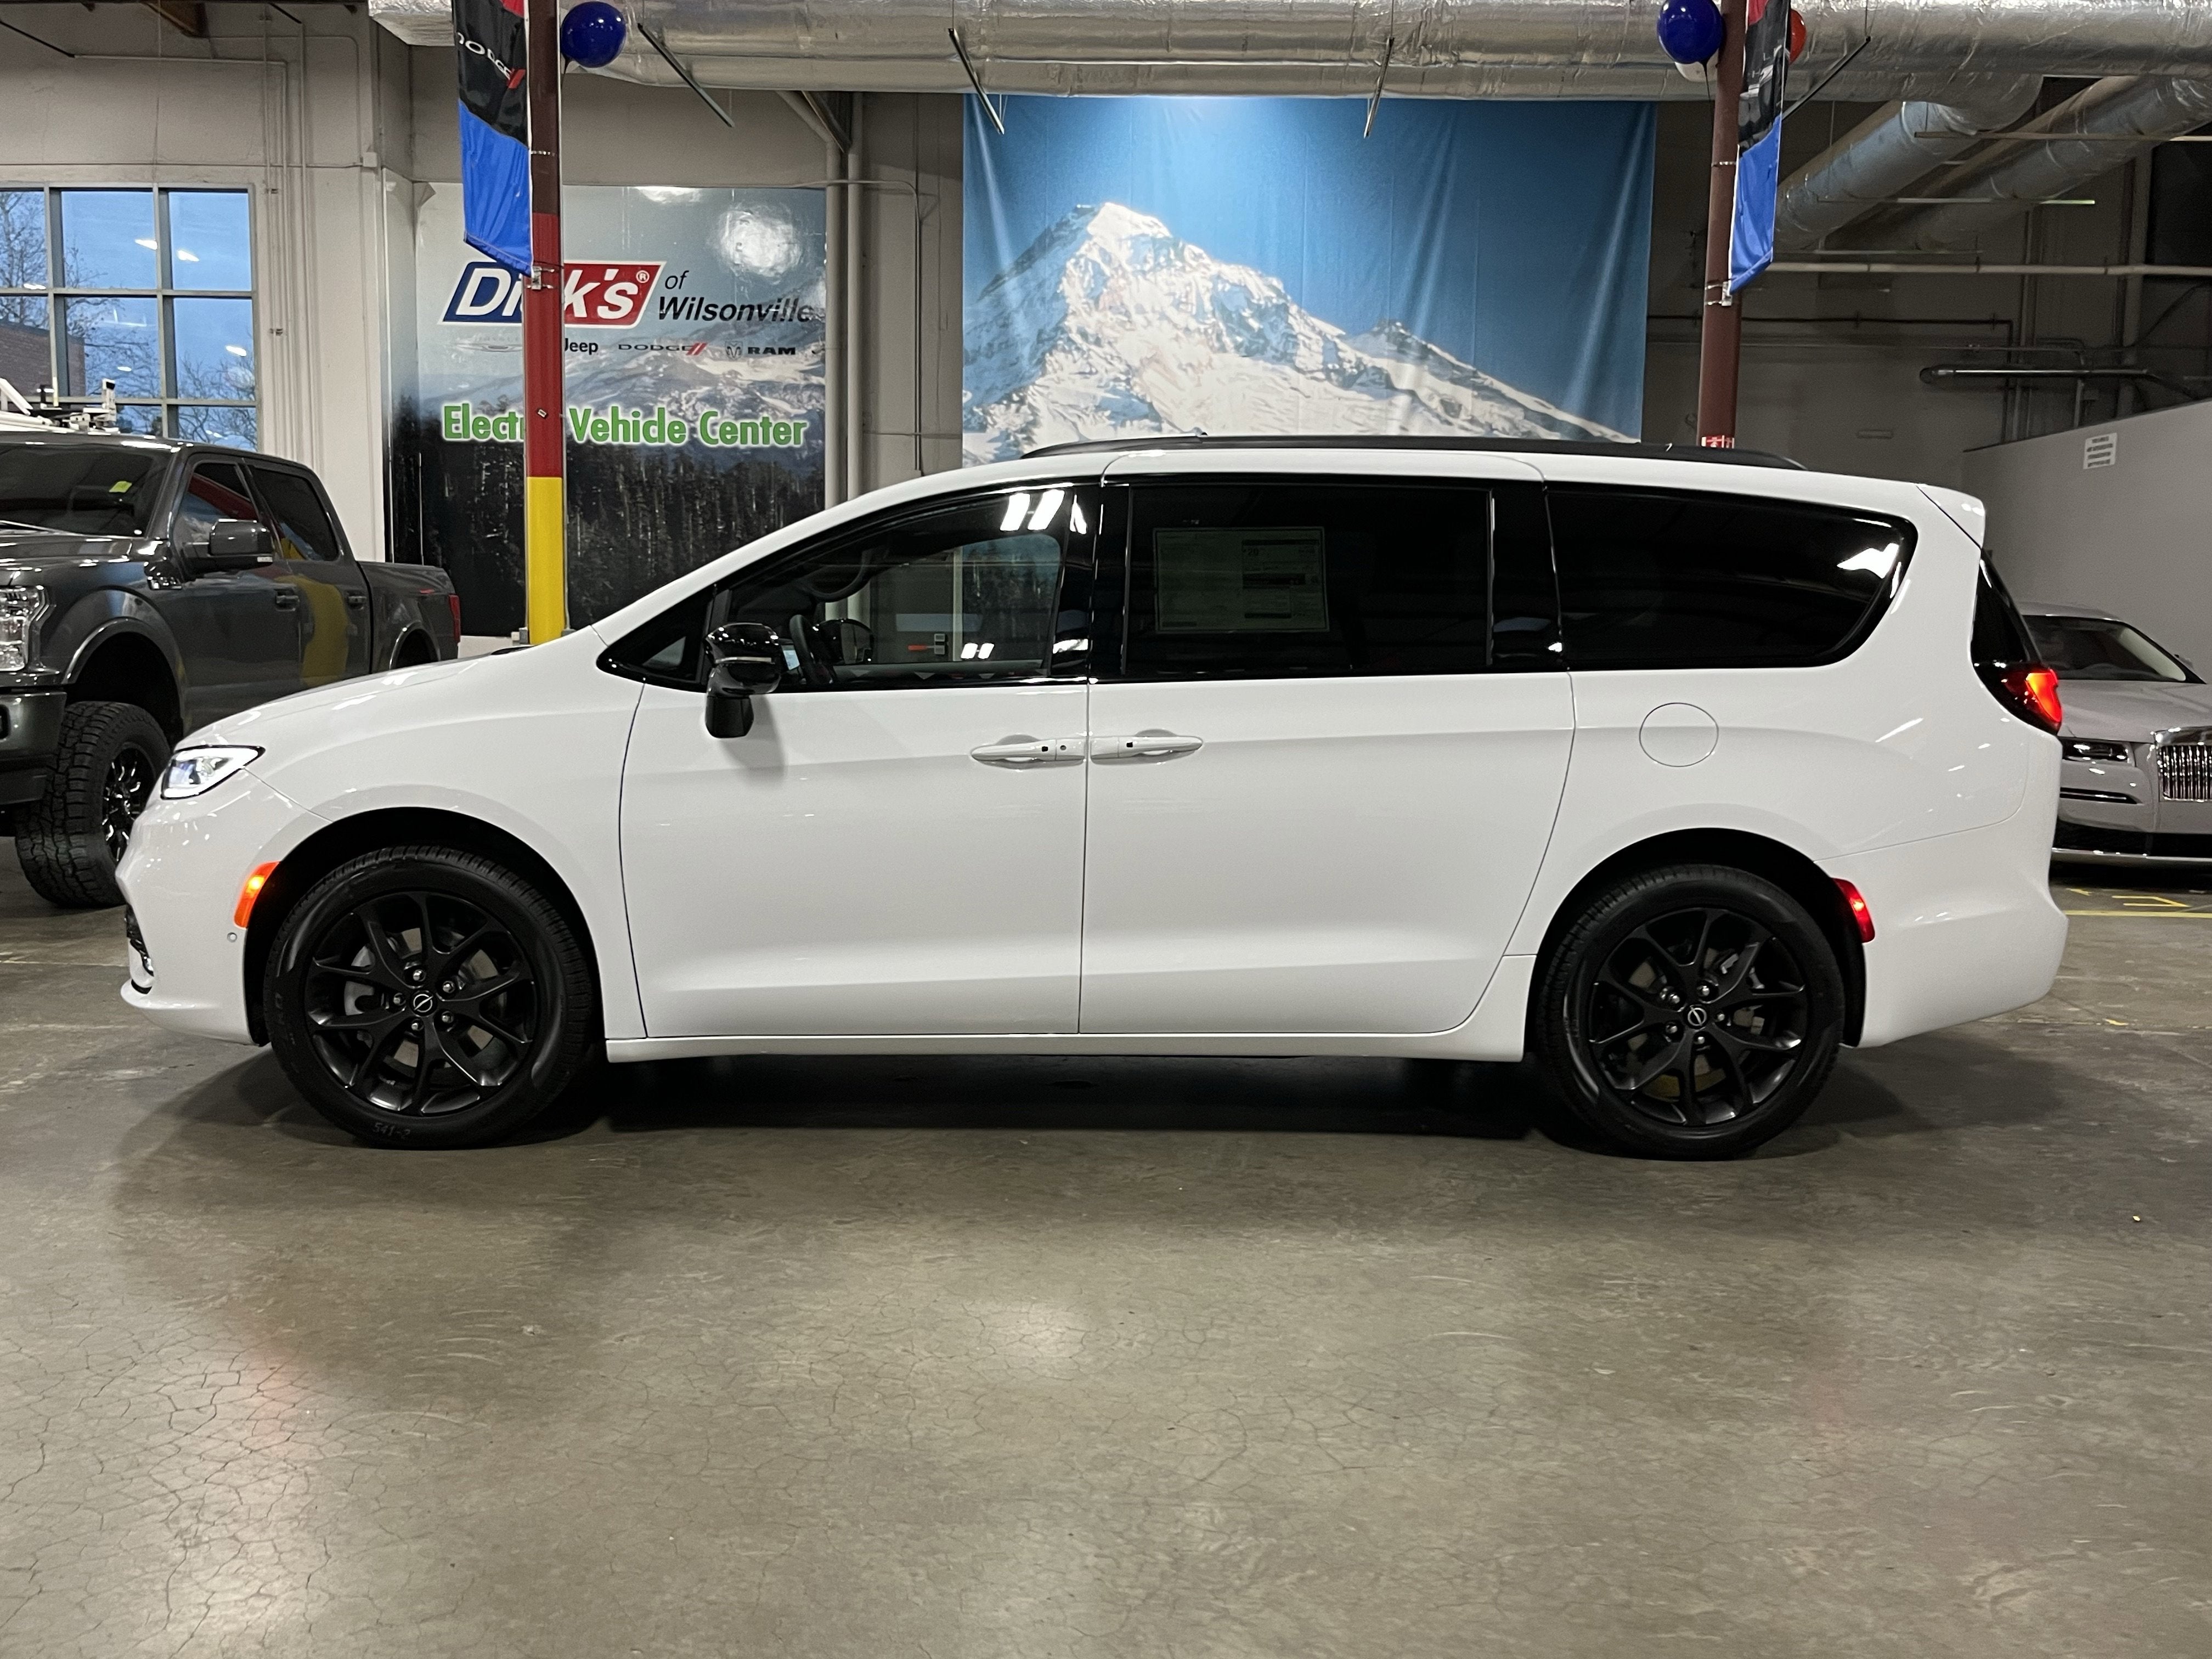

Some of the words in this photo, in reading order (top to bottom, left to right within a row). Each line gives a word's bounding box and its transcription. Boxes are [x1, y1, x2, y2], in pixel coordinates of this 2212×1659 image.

[664, 270, 689, 290] of
[455, 268, 639, 319] Dik's
[659, 296, 815, 322] Wilsonville
[747, 347, 796, 355] RAM
[444, 403, 524, 439] Elect
[569, 405, 686, 444] Vehicle
[700, 410, 808, 445] Center
